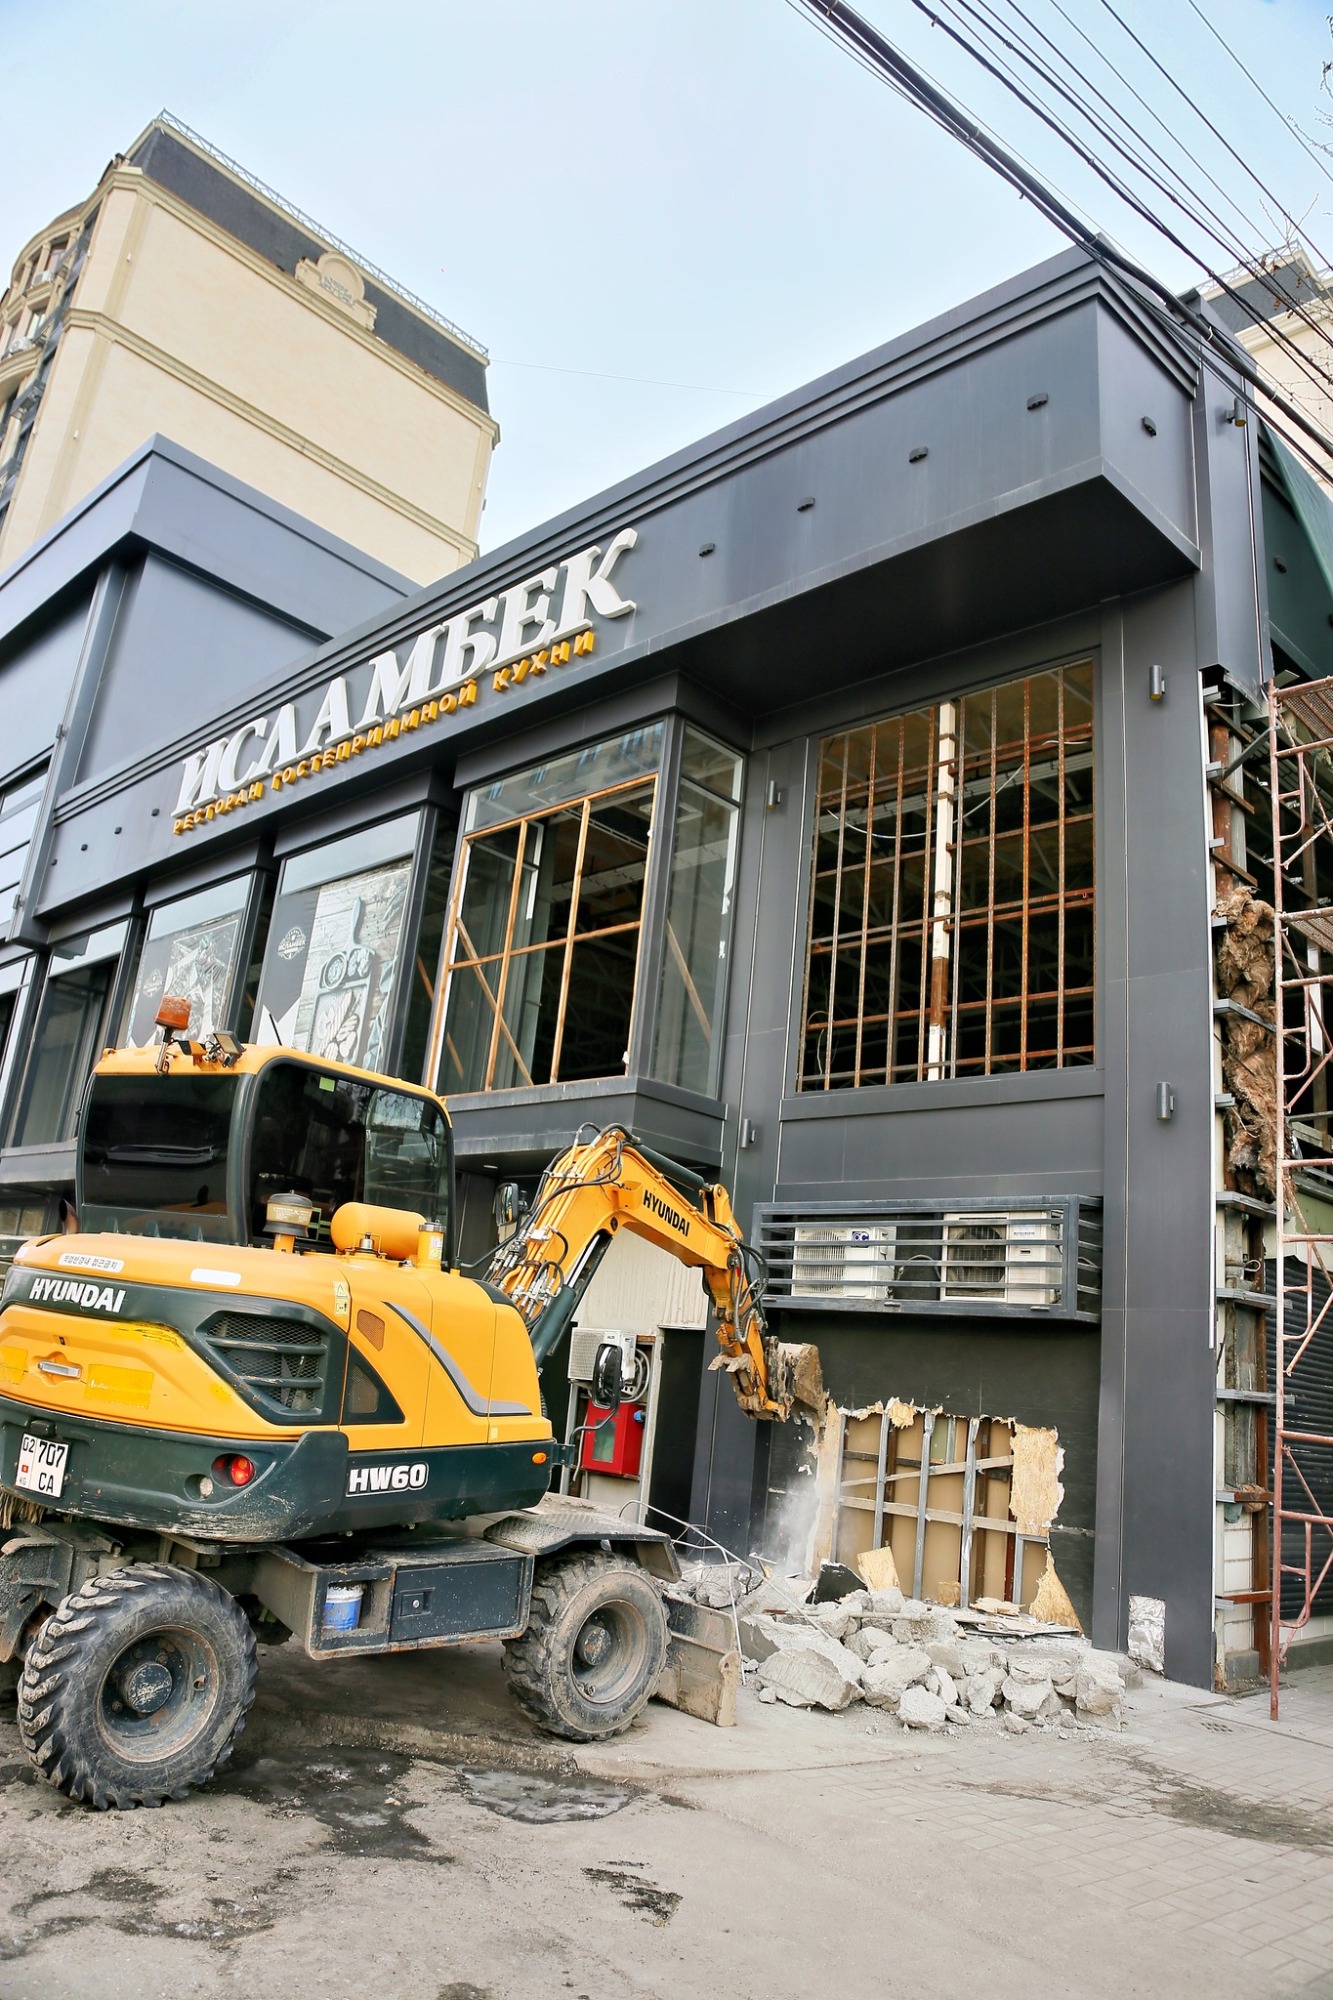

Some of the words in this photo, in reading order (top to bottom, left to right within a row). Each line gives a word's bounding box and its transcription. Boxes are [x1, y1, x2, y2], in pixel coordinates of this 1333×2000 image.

[170, 527, 638, 819] ИСЛАМБЕК
[172, 781, 265, 836] РЕСТОРАН
[271, 678, 478, 790] ГОСТЕПРИИМНОЙ
[492, 630, 595, 692] КУХНИ
[642, 1189, 690, 1237] HYUNDAI
[28, 1277, 127, 1313] HYUNDAI
[22, 1436, 36, 1453] 02
[38, 1440, 66, 1468] 707
[38, 1472, 54, 1494] CA
[348, 1463, 428, 1493] HW60
